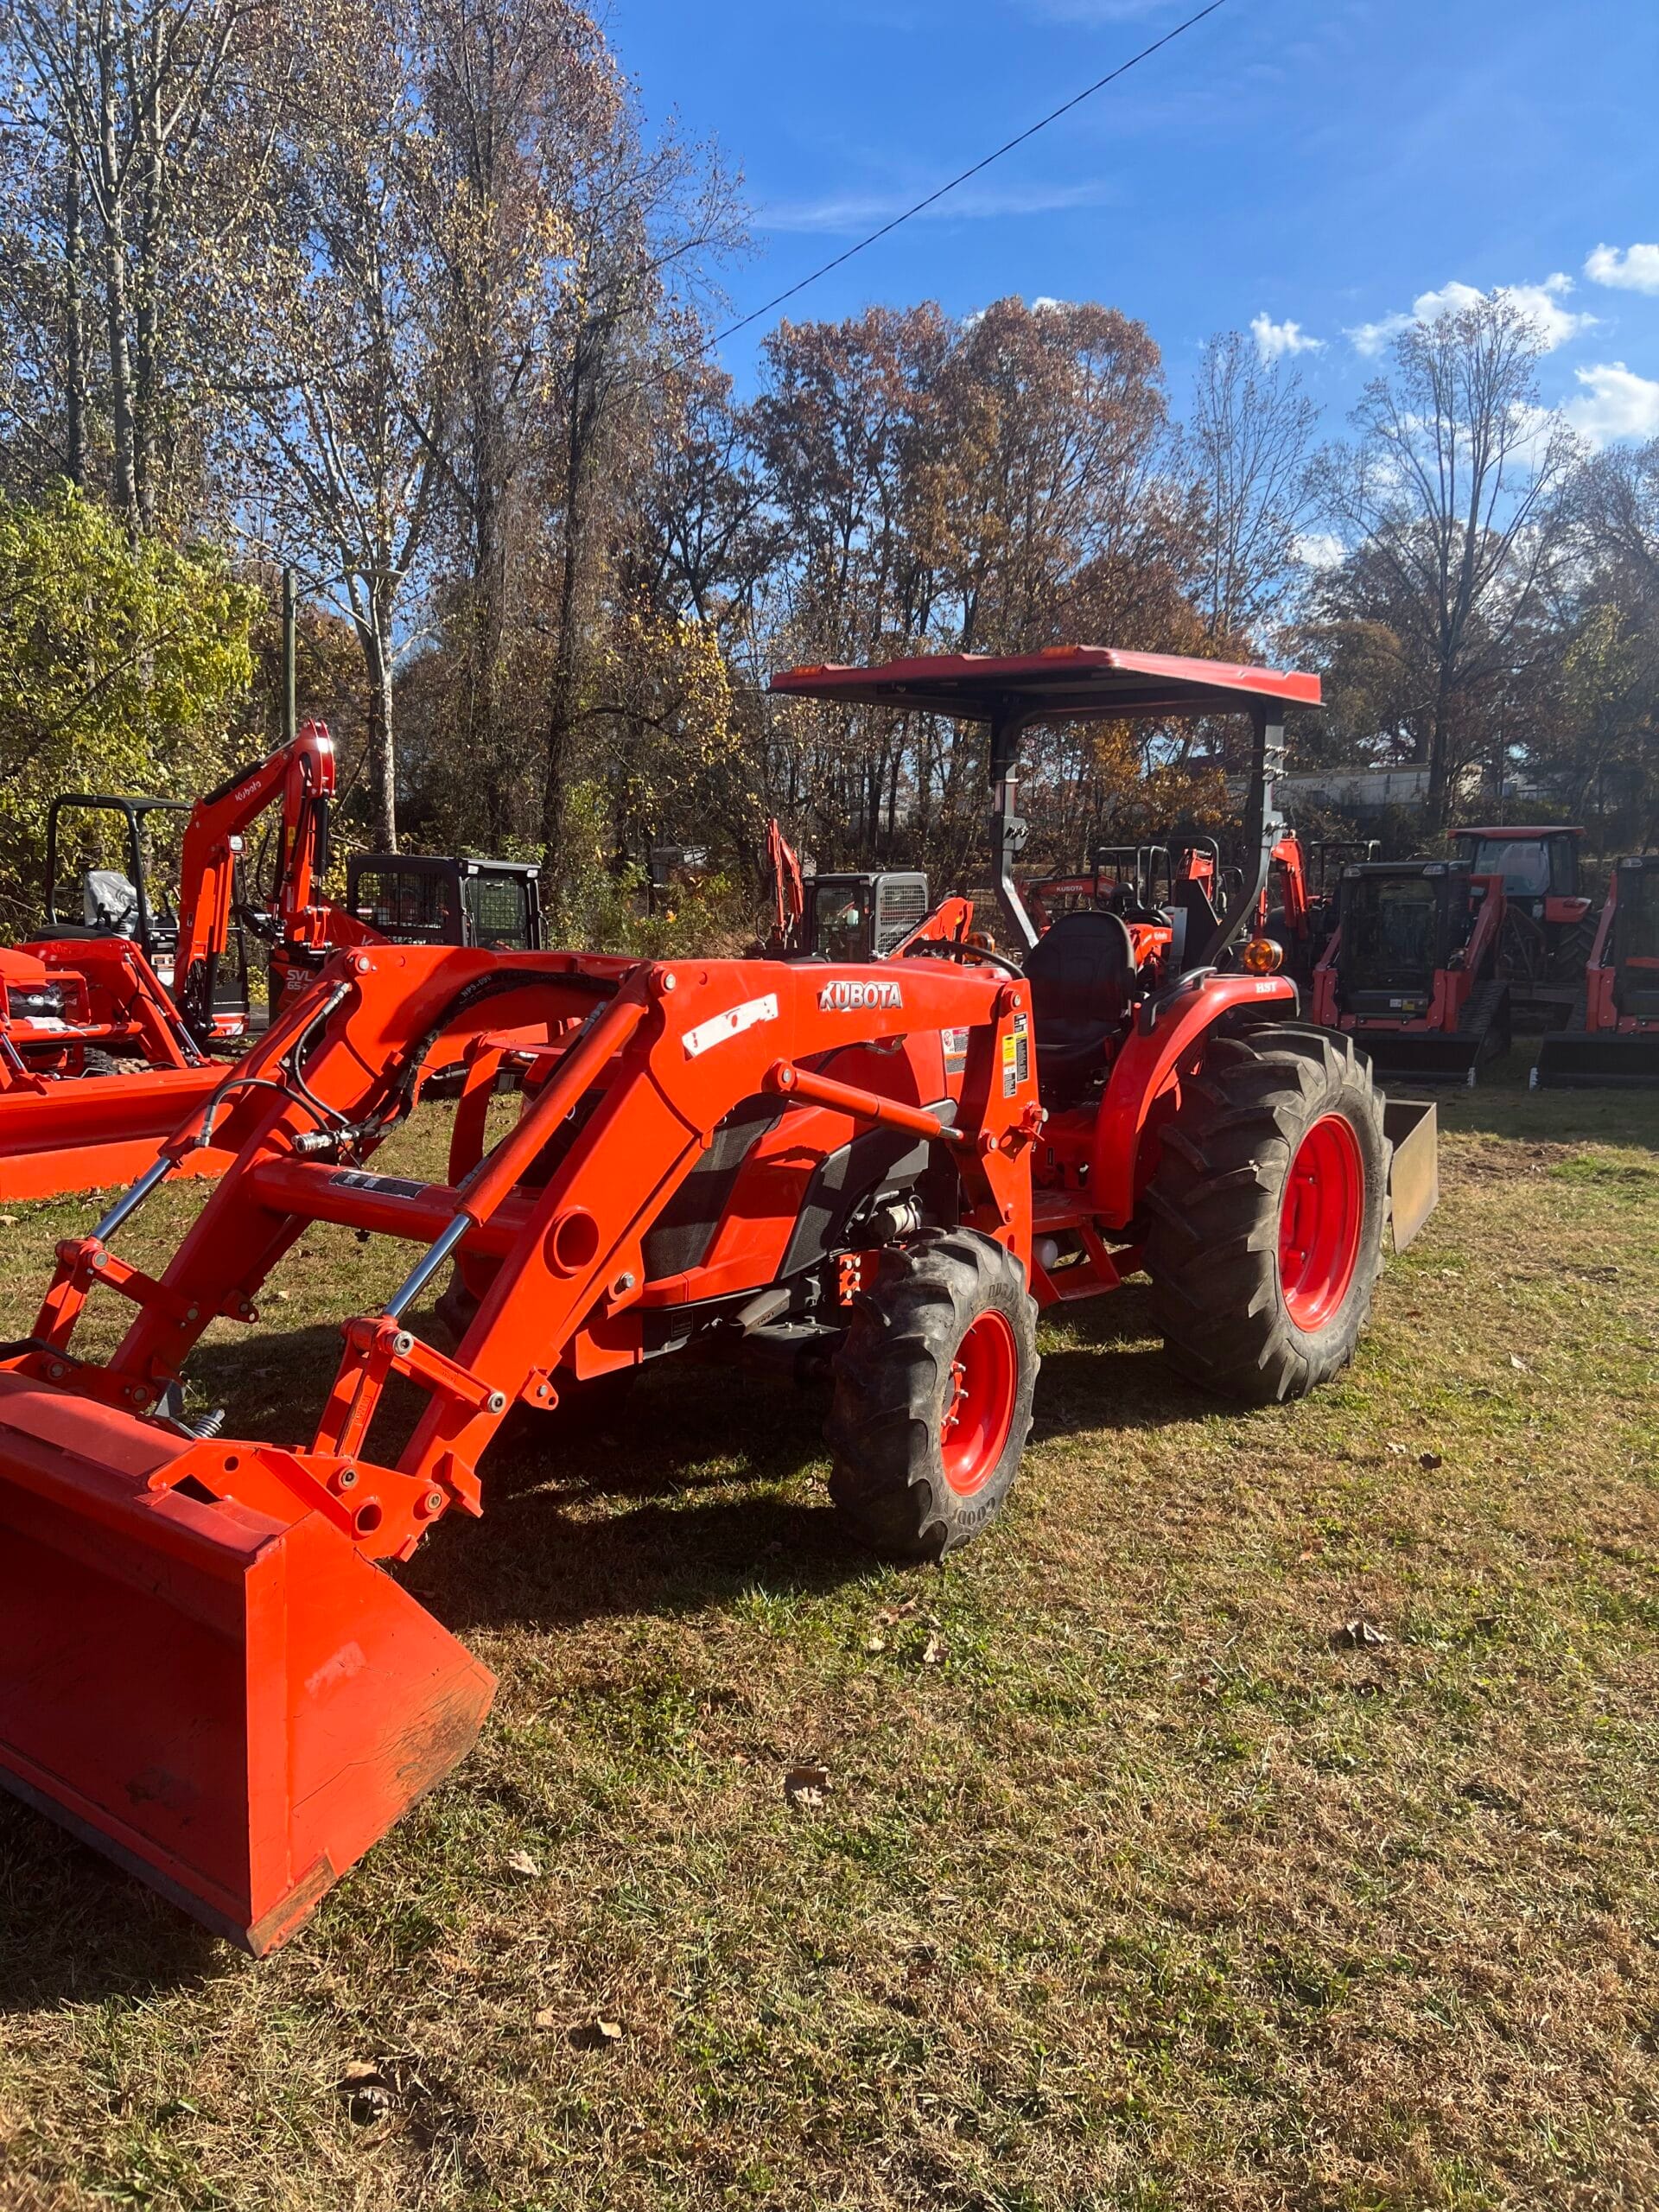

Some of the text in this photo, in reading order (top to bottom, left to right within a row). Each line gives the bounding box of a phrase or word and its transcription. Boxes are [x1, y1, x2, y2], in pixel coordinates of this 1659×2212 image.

[235, 780, 262, 801] Kubota
[286, 969, 314, 982] SVL
[820, 982, 902, 1010] KUBOTA
[1255, 981, 1278, 994] HST
